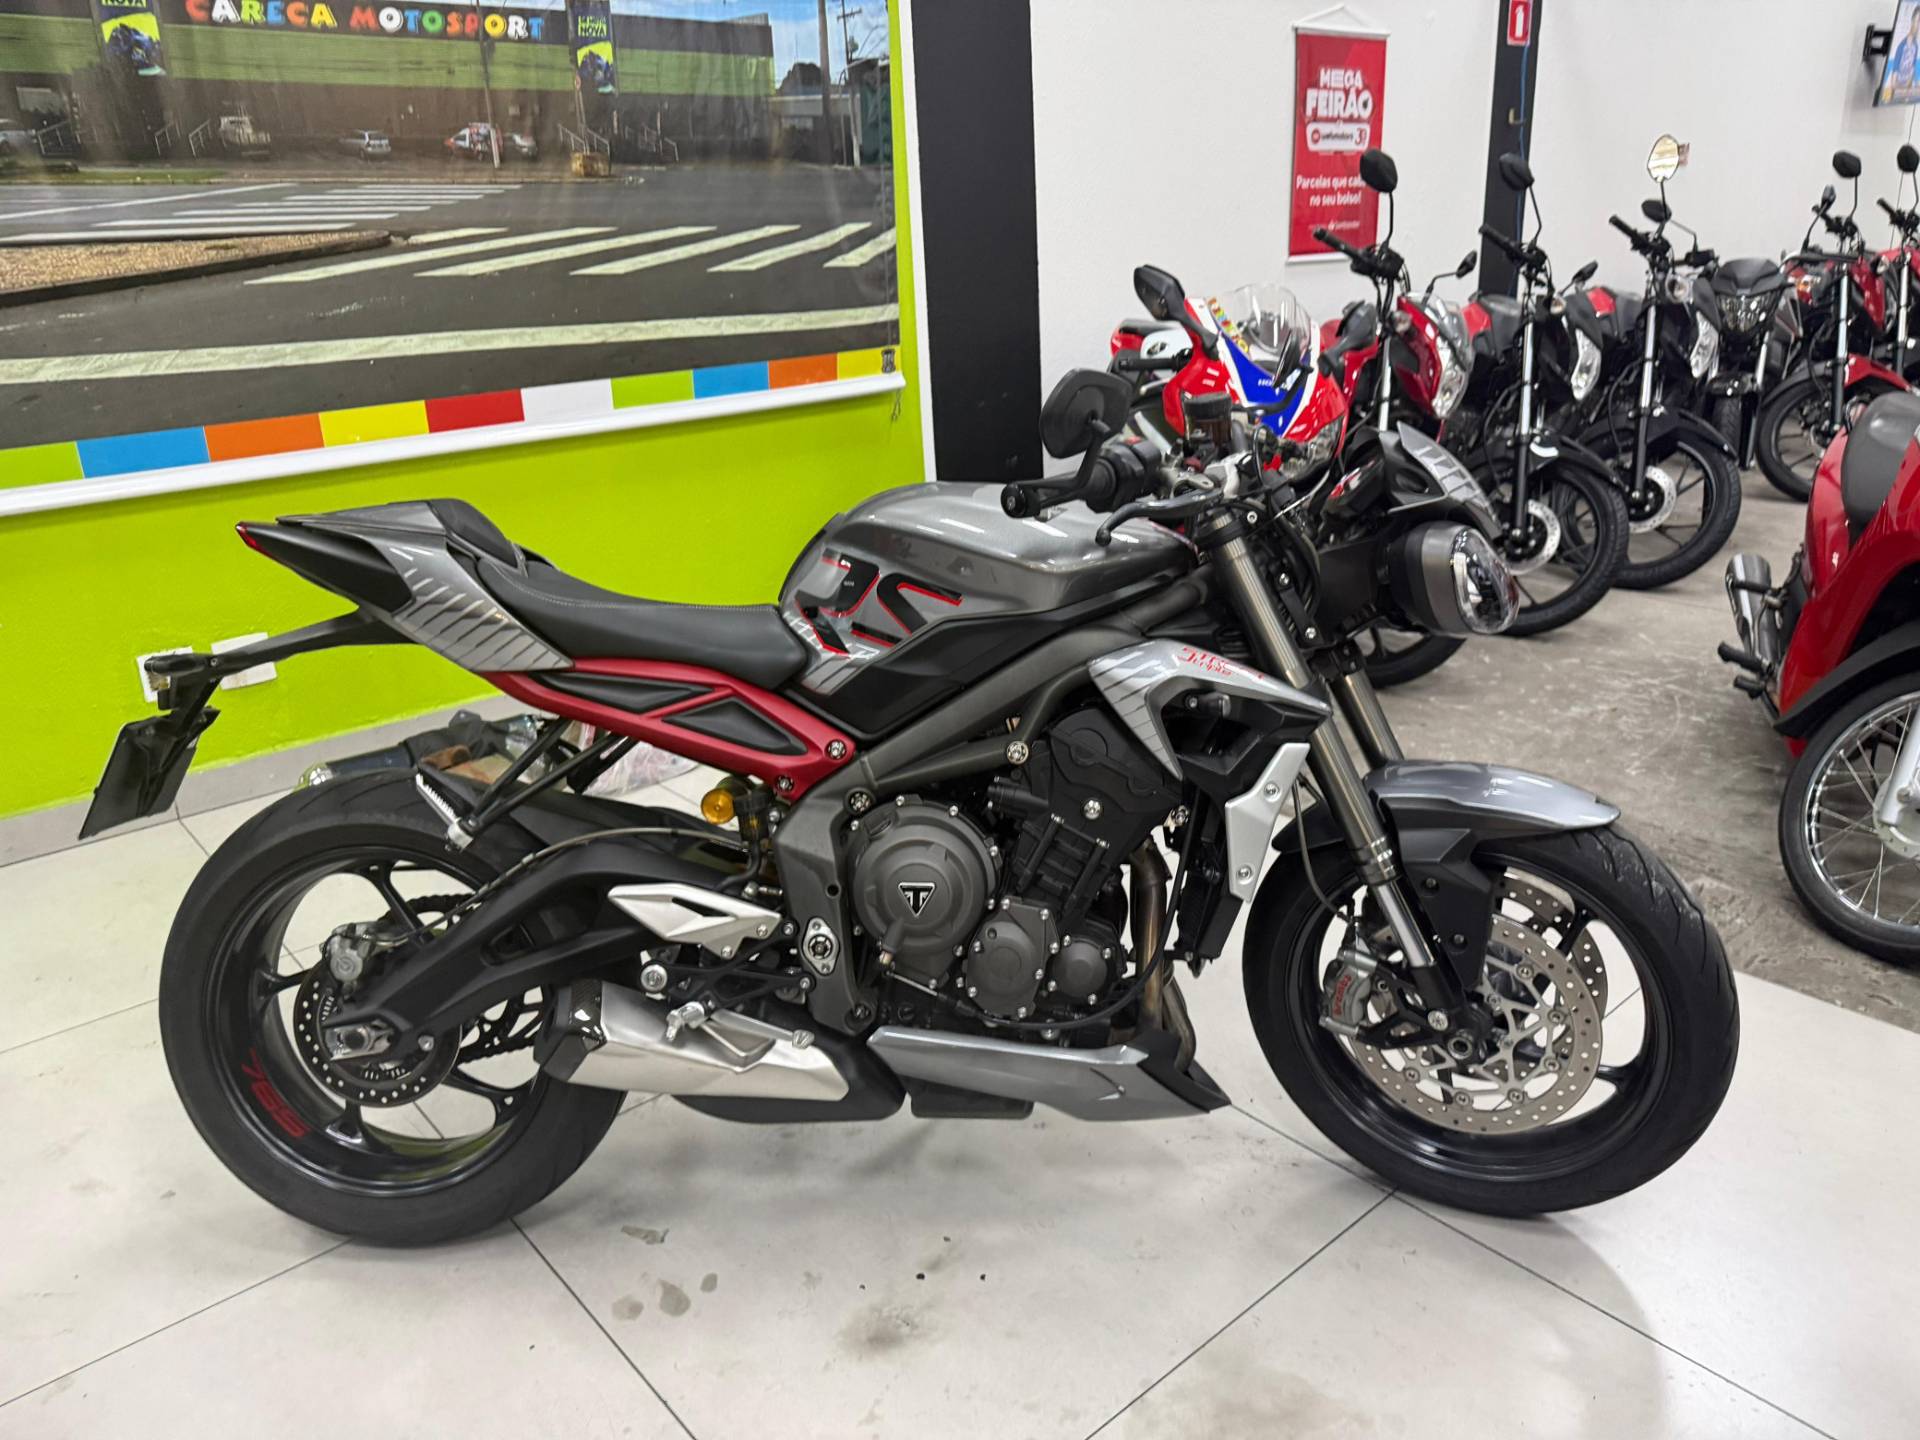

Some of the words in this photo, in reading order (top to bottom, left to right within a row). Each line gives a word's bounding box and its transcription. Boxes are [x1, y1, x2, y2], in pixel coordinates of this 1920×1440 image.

[185, 0, 338, 28] CARECA
[350, 6, 545, 40] MOTOSPORT
[1320, 67, 1363, 89] MEGA
[1306, 88, 1373, 119] FEIRÃO
[1296, 174, 1331, 190] Parcelas
